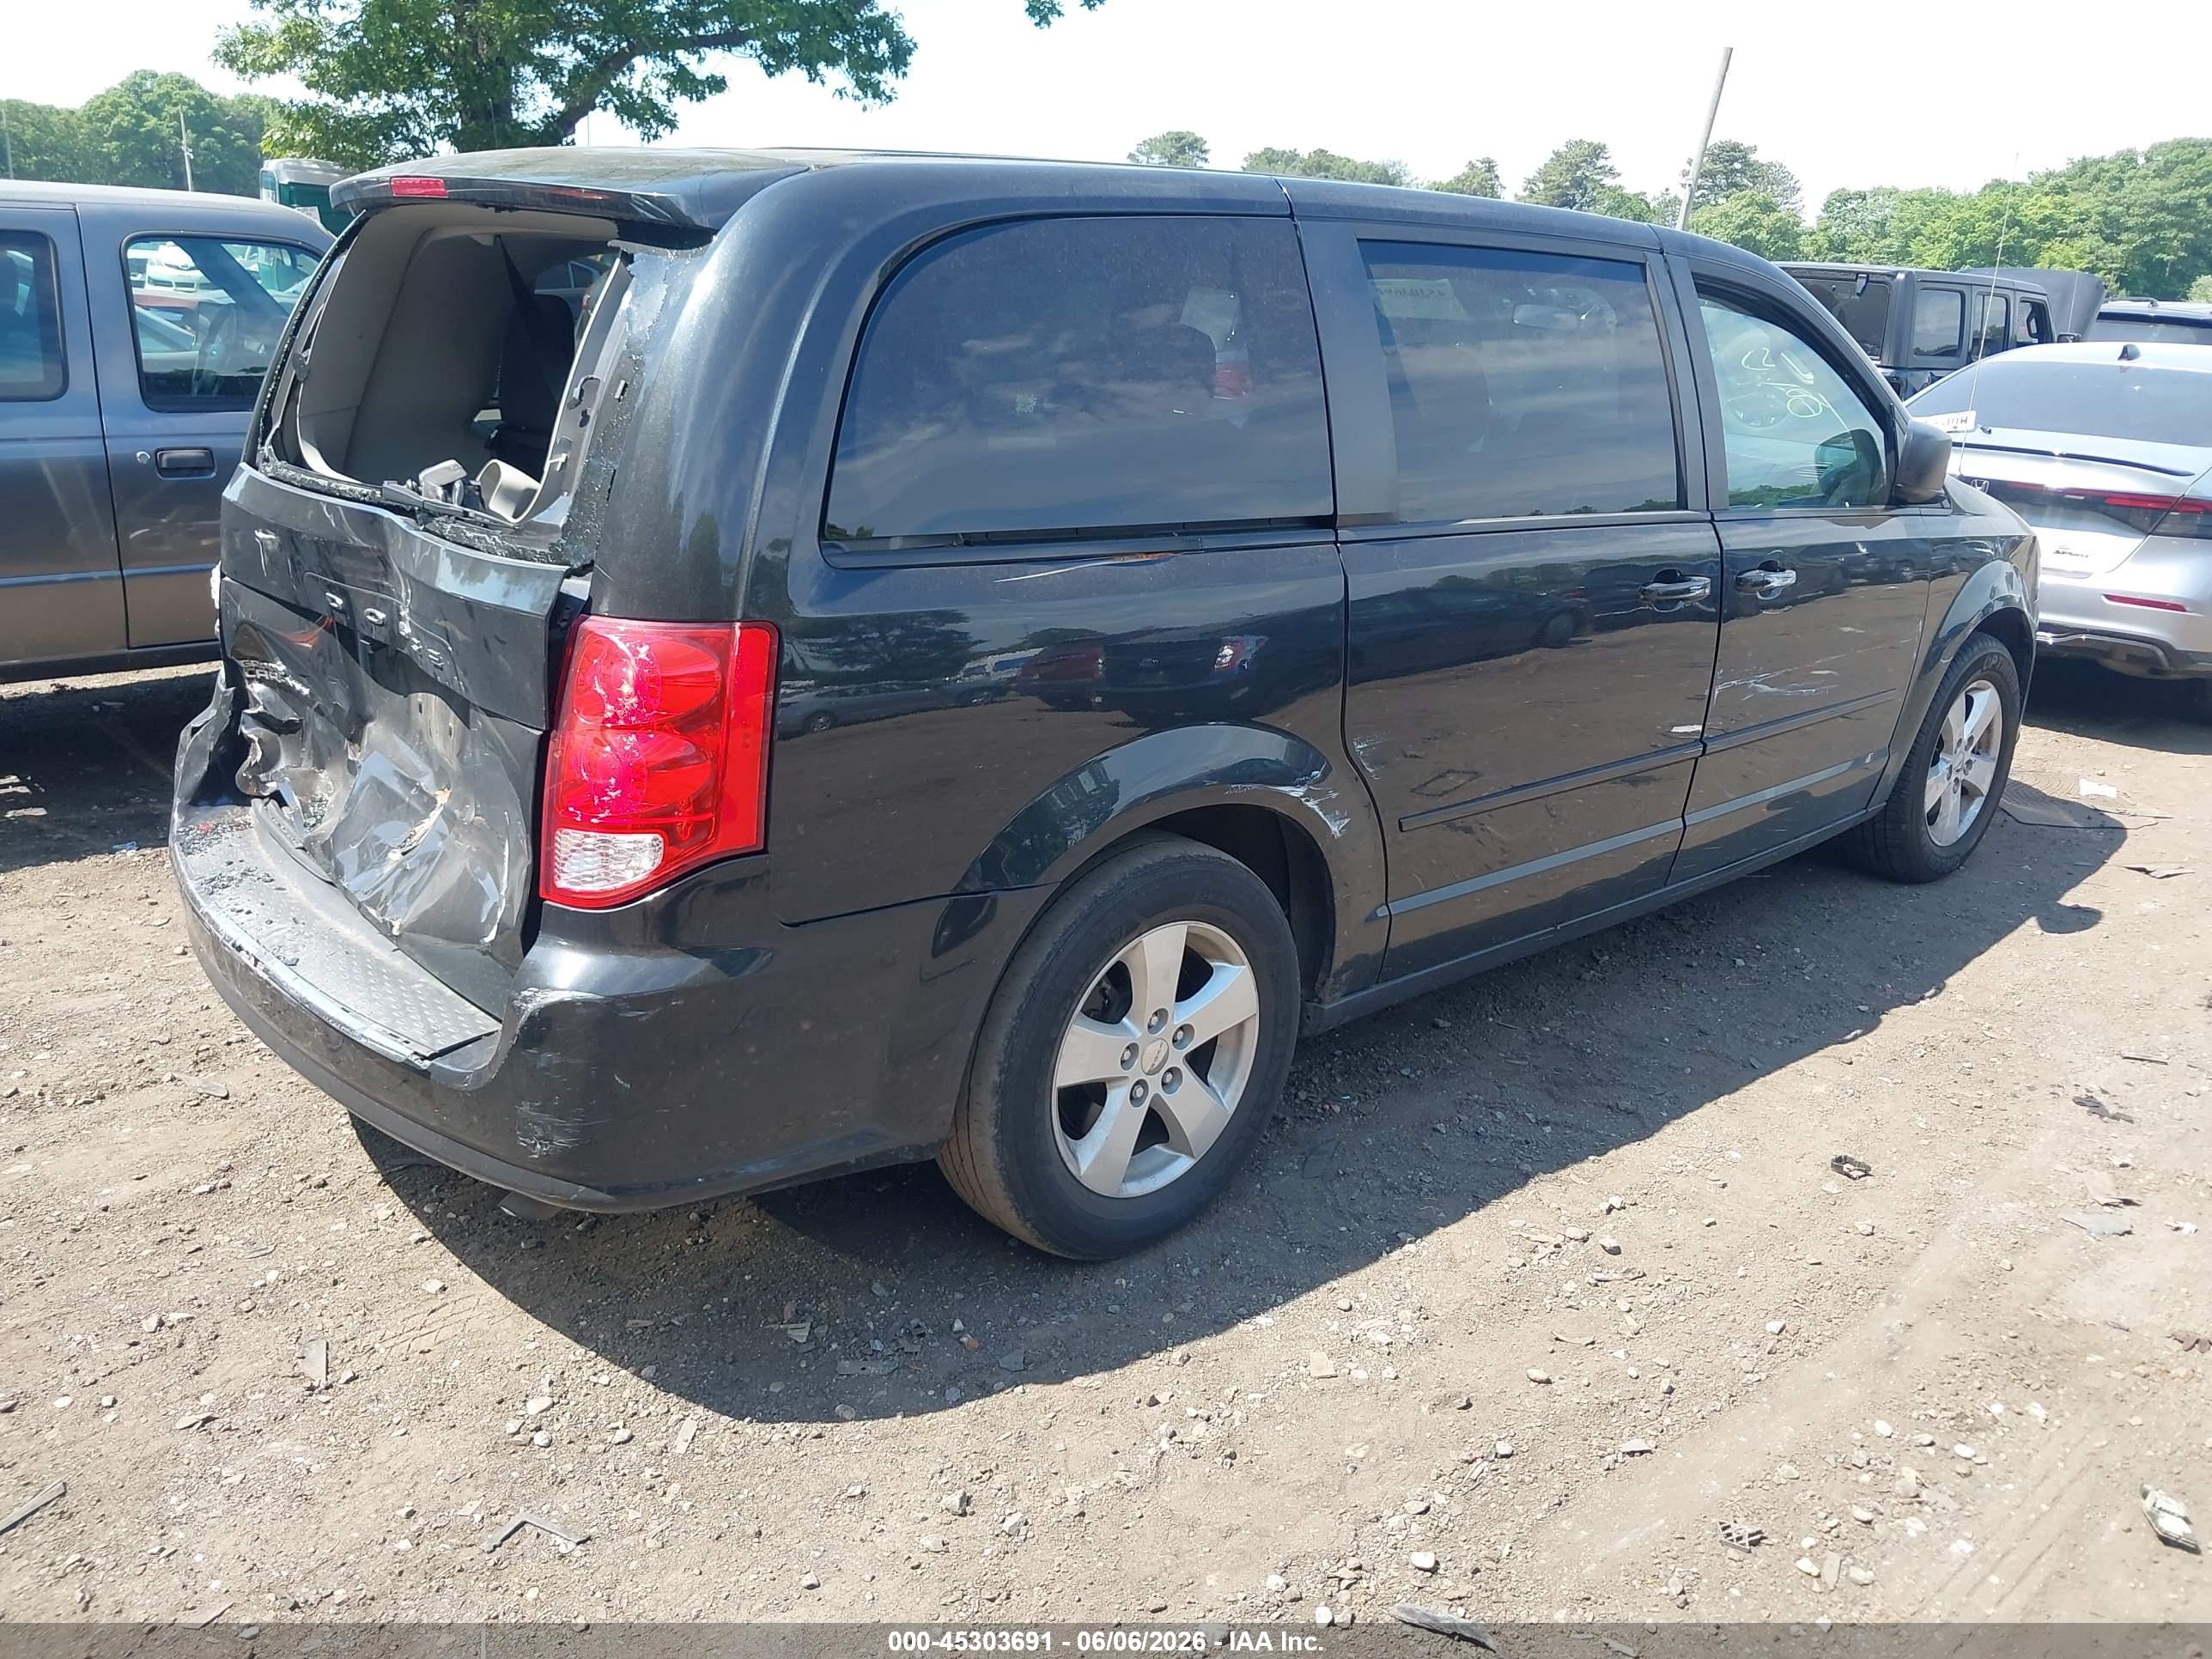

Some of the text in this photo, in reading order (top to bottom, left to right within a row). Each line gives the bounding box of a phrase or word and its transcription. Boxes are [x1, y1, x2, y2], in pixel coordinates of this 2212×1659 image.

[324, 591, 445, 665] DOE
[241, 659, 286, 672] GRA
[244, 667, 311, 696] CARA
